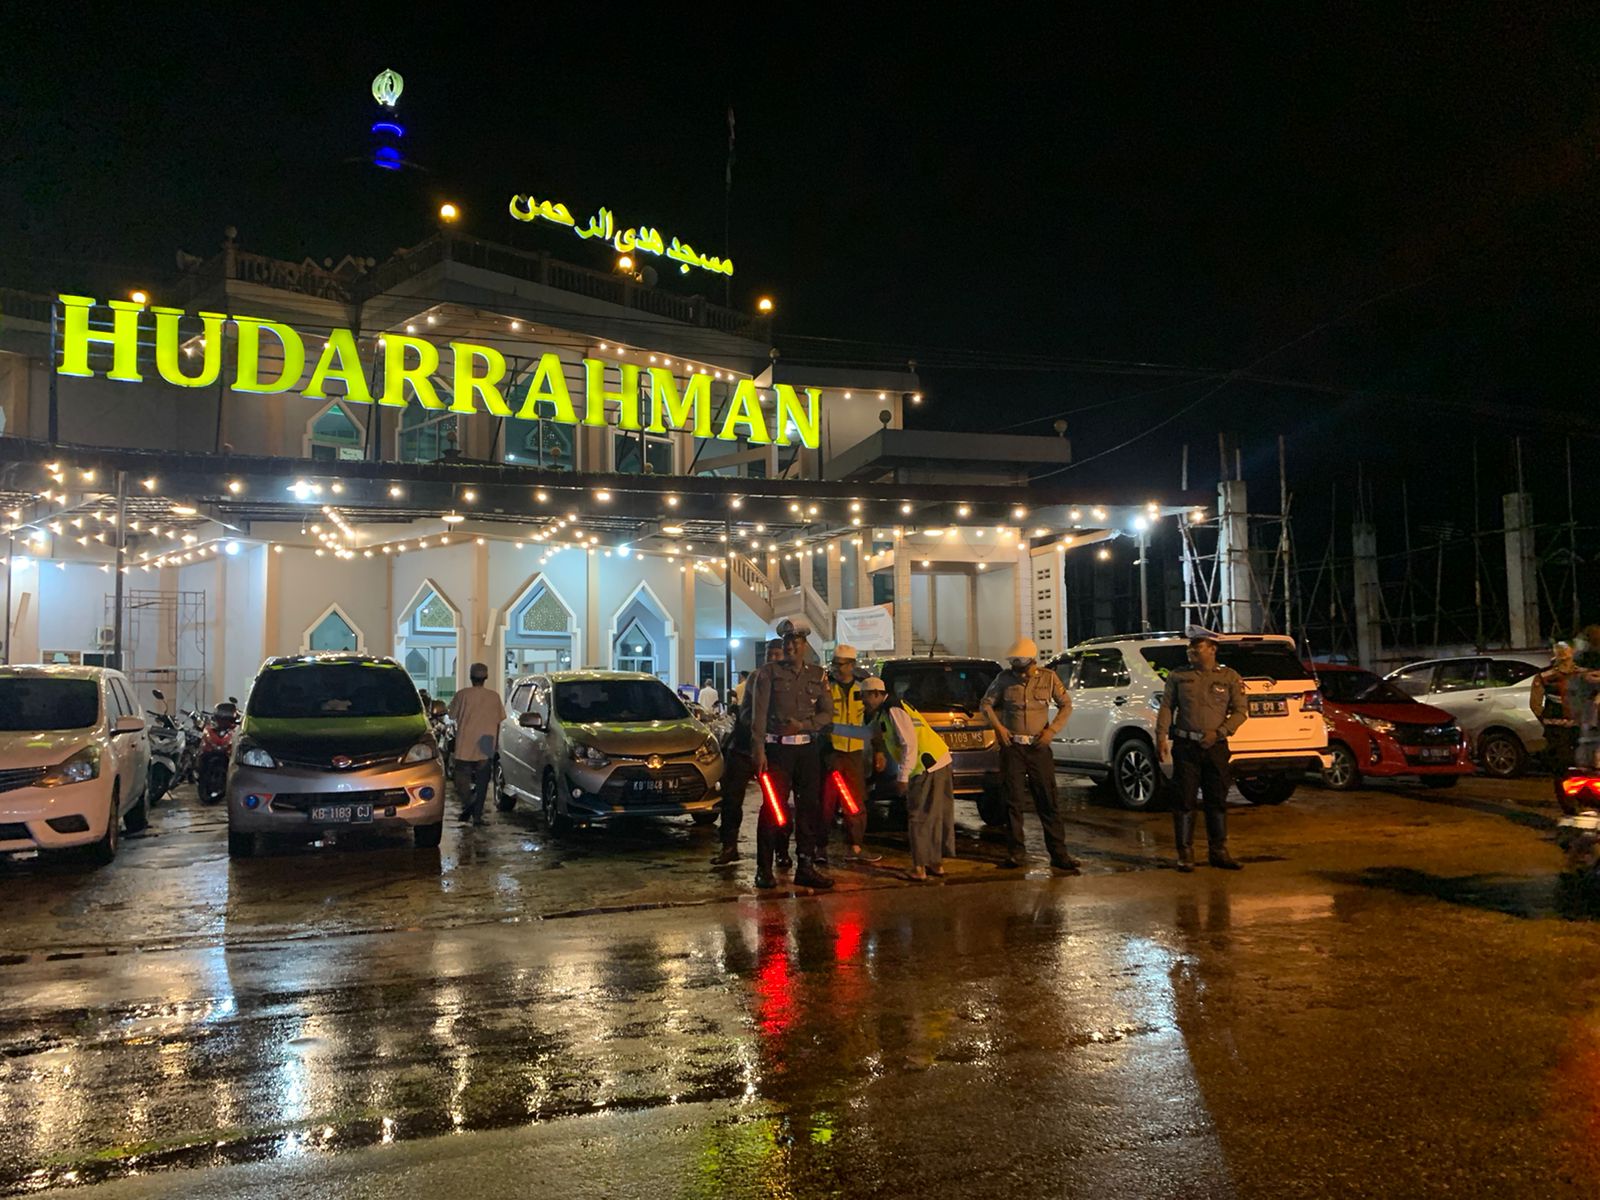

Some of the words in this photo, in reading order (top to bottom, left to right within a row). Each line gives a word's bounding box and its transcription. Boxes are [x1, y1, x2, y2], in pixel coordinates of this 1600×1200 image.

[614, 225, 665, 254] هدى
[667, 236, 734, 276] مسجد
[56, 293, 823, 450] HUDARRAHMAN
[950, 732, 968, 743] 1109
[311, 808, 325, 820] KB
[330, 807, 352, 818] 1183
[356, 806, 370, 817] CJ
